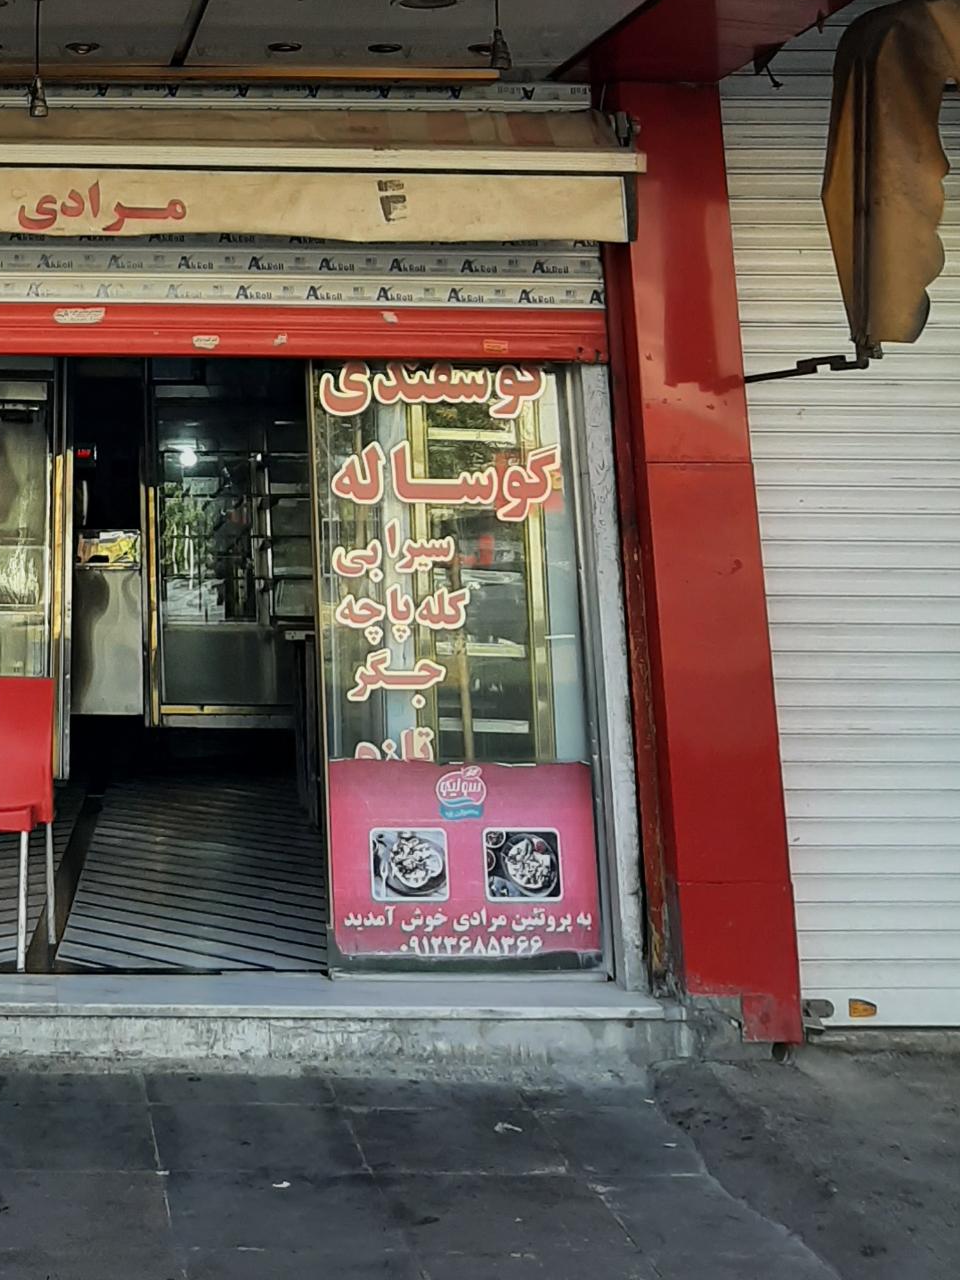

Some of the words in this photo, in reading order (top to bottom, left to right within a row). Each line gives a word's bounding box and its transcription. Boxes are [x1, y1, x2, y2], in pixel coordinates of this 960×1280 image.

[18, 180, 187, 232] مرادی
[331, 440, 561, 521] گوساله
[332, 518, 456, 582] سیرابی
[347, 647, 447, 710] جگر
[343, 906, 396, 933] آمدید
[401, 907, 448, 934] خوش
[453, 907, 507, 933] مرادی
[577, 909, 593, 932] به
[400, 935, 544, 955] ۰۹۱۲۳۶۸۵۳۶۶
